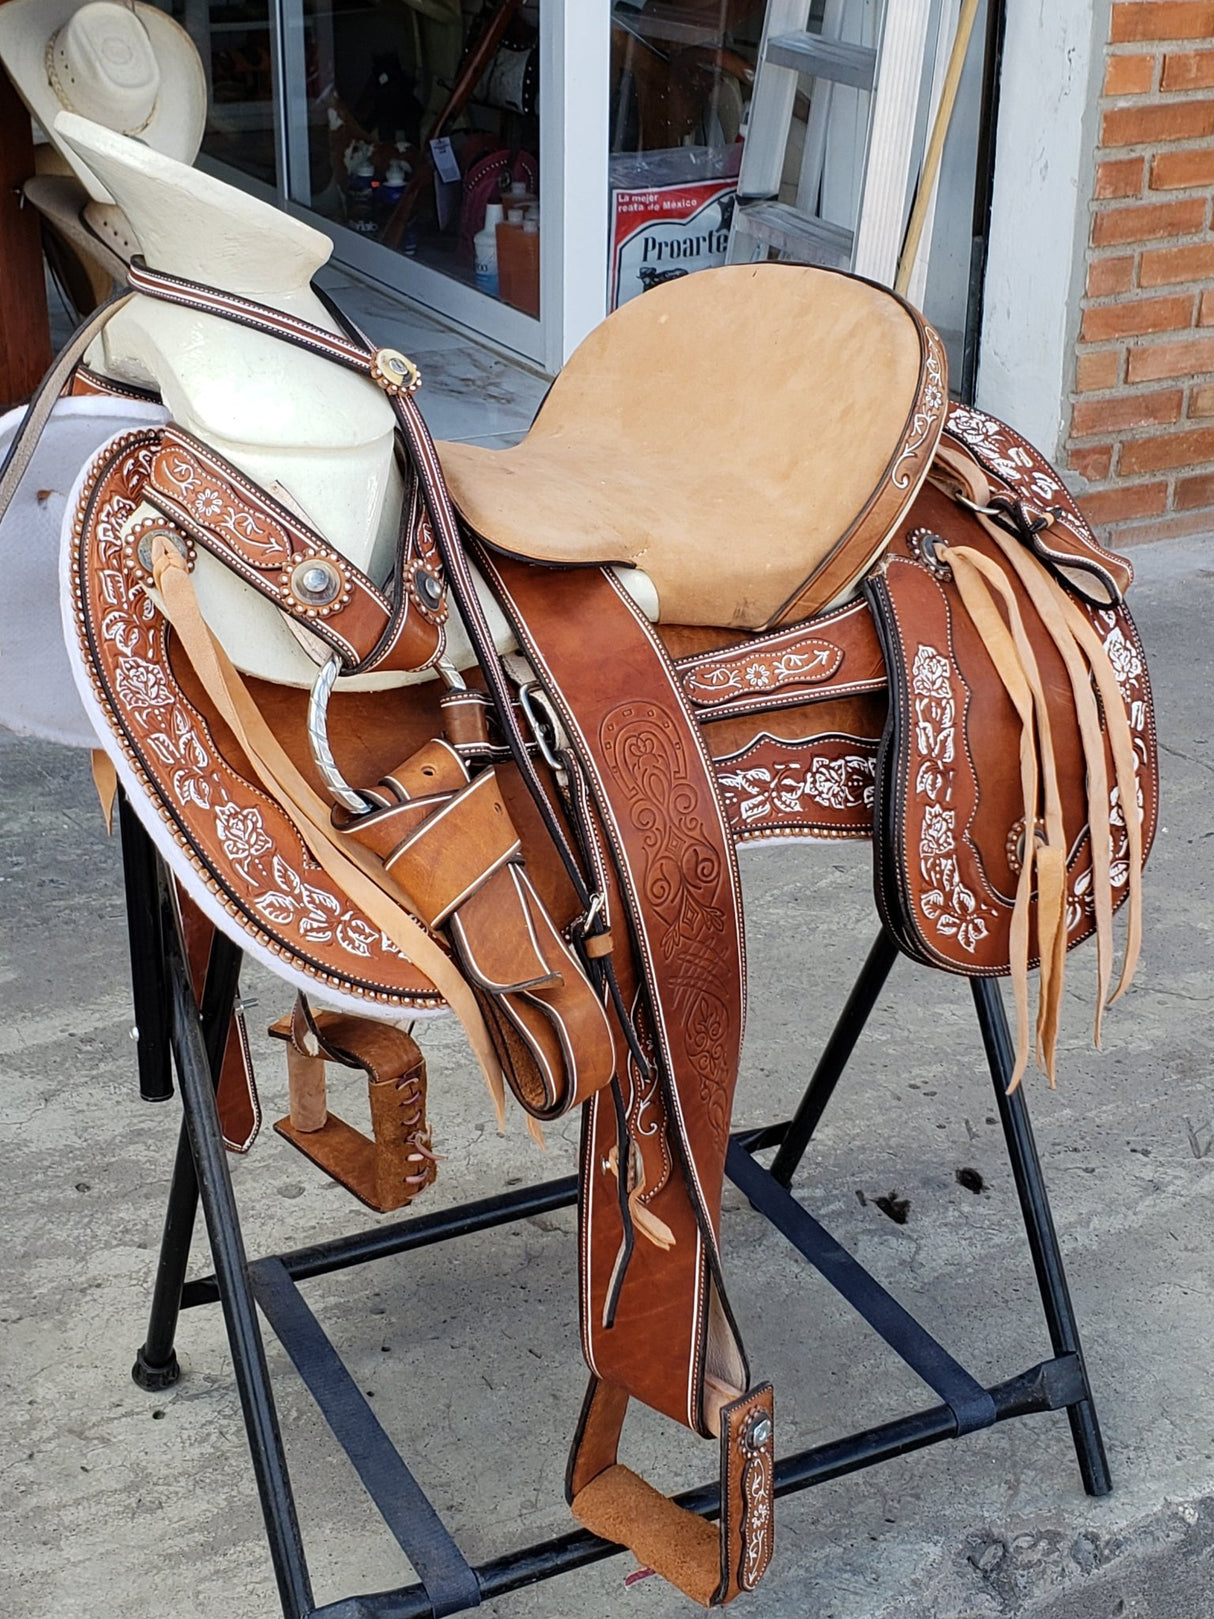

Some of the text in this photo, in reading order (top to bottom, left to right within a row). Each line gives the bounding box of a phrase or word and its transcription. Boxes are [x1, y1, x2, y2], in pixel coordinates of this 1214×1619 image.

[618, 193, 659, 204] La mejor
[618, 203, 644, 213] reata
[647, 202, 660, 212] de
[642, 229, 729, 262] Proarte
